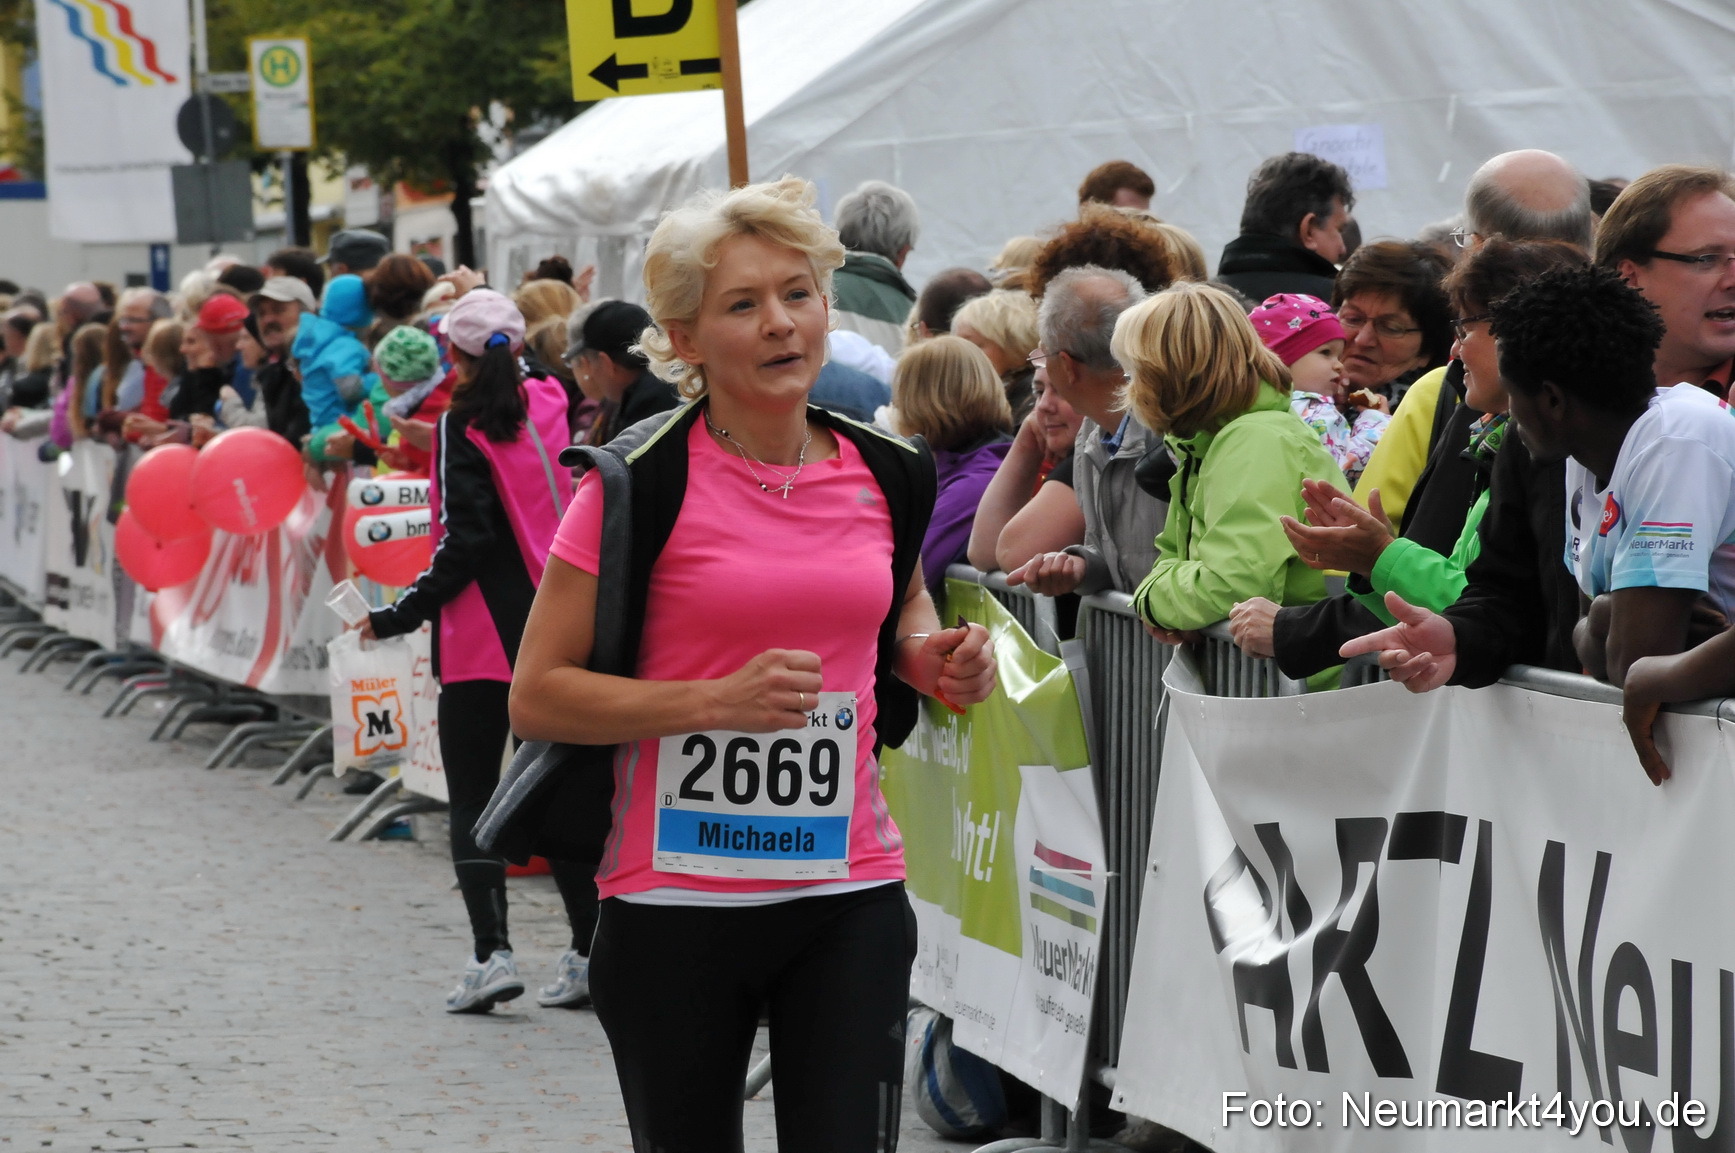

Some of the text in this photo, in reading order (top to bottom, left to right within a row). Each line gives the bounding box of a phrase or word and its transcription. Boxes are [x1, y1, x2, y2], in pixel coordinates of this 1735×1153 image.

[1629, 539, 1695, 552] NeuerMarkt
[351, 677, 397, 693] Müller
[366, 709, 394, 738] M
[679, 734, 840, 807] 2669
[664, 794, 673, 806] D
[698, 821, 815, 852] Michaela
